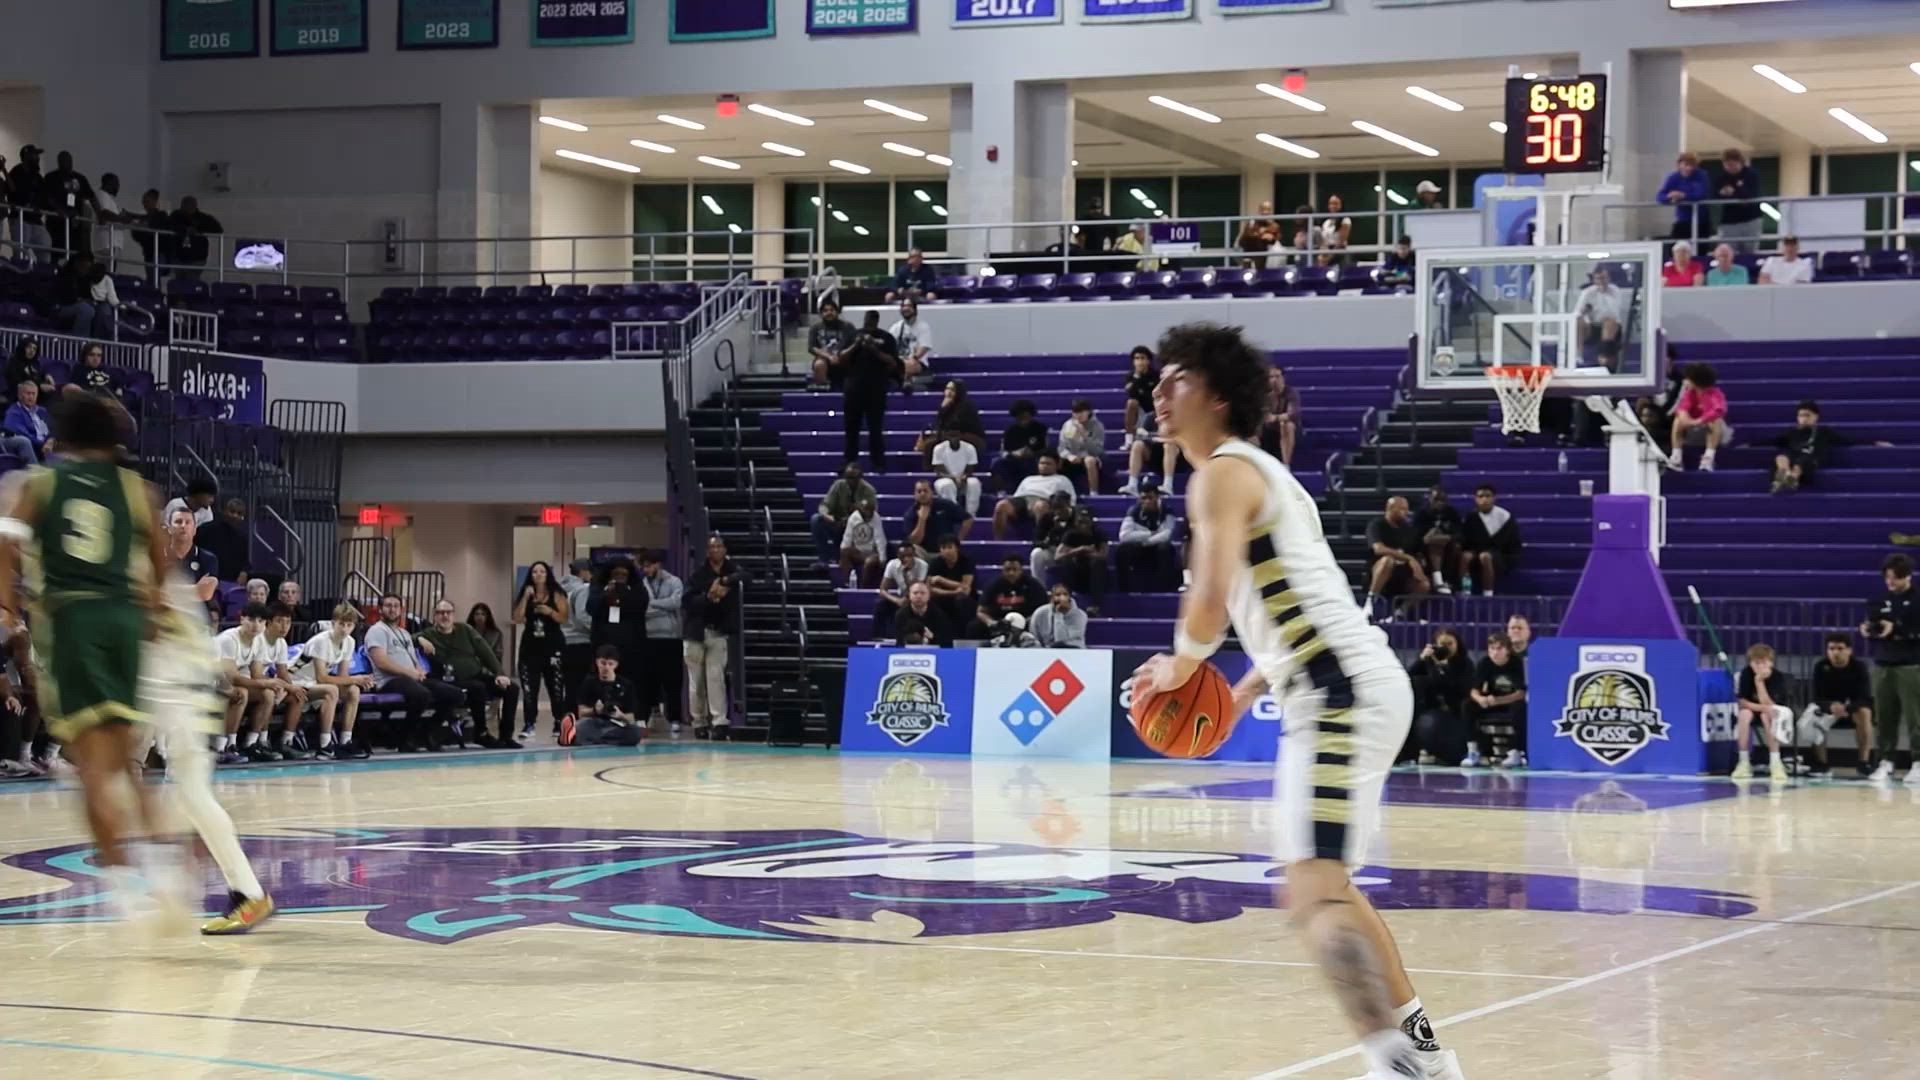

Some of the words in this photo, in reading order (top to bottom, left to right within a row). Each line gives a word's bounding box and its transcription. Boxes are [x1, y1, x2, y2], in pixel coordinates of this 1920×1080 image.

[540, 4, 566, 18] 2023
[569, 3, 596, 17] 2024
[600, 2, 625, 16] 2025
[814, 9, 858, 24] 2024
[863, 7, 907, 22] 2025
[971, 0, 1037, 17] 2017
[298, 28, 339, 44] 2019
[424, 22, 470, 38] 2023
[189, 33, 230, 48] 2016
[1530, 81, 1596, 113] 6:48
[1526, 114, 1582, 164] 30
[1170, 227, 1191, 241] 101
[61, 498, 114, 565] 3
[1585, 652, 1638, 664] GEICO
[878, 702, 898, 714] CITY
[900, 702, 913, 712] OF
[1568, 710, 1598, 724] CITY
[1599, 708, 1618, 720] OF
[886, 715, 928, 728] CLASSIC
[1581, 726, 1639, 742] CLASSIC
